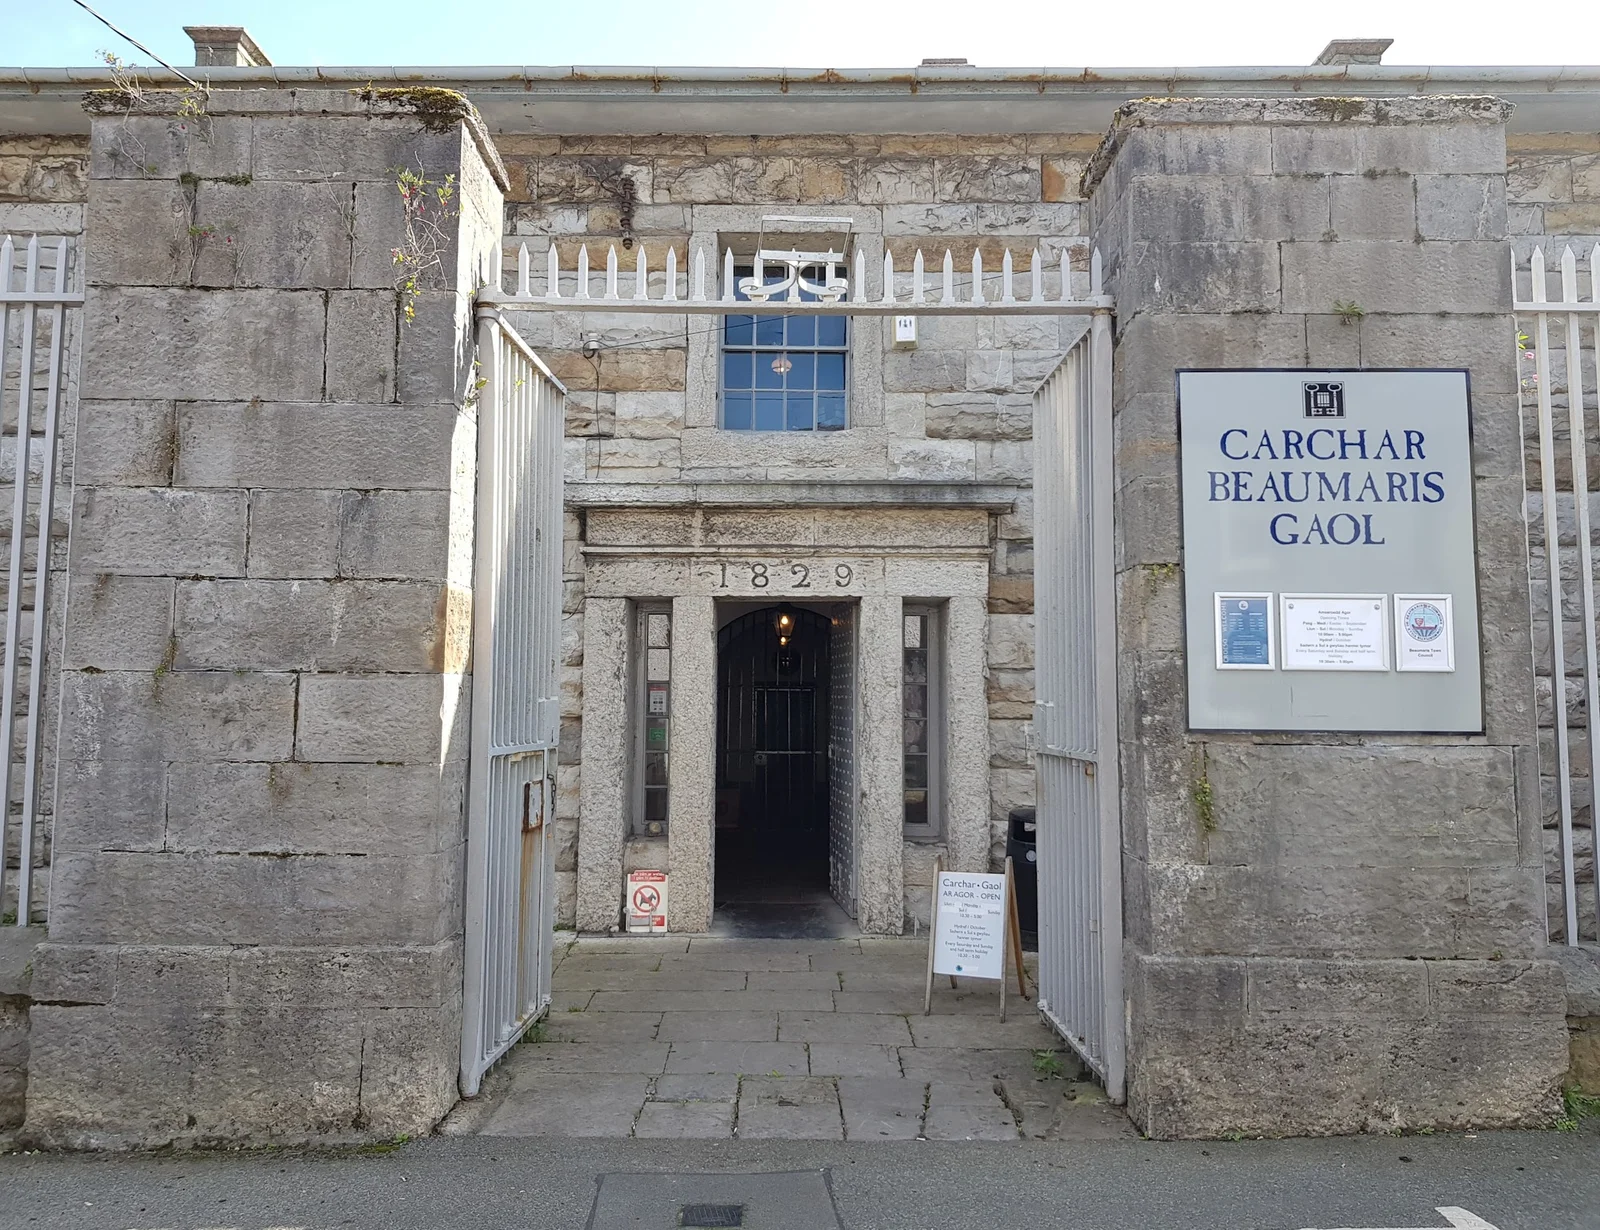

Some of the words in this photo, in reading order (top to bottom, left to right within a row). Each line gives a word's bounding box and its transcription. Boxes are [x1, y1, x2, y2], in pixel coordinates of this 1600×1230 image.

[1220, 429, 1426, 460] CARCHAR
[1207, 471, 1445, 503] BEAUMARIS
[1269, 513, 1385, 545] GAOL
[719, 562, 853, 588] 1829
[942, 878, 977, 888] Carchar
[981, 880, 1002, 890] Gaol
[942, 890, 953, 898] AR
[953, 891, 975, 899] AGOR
[980, 892, 1001, 901] OPEN
